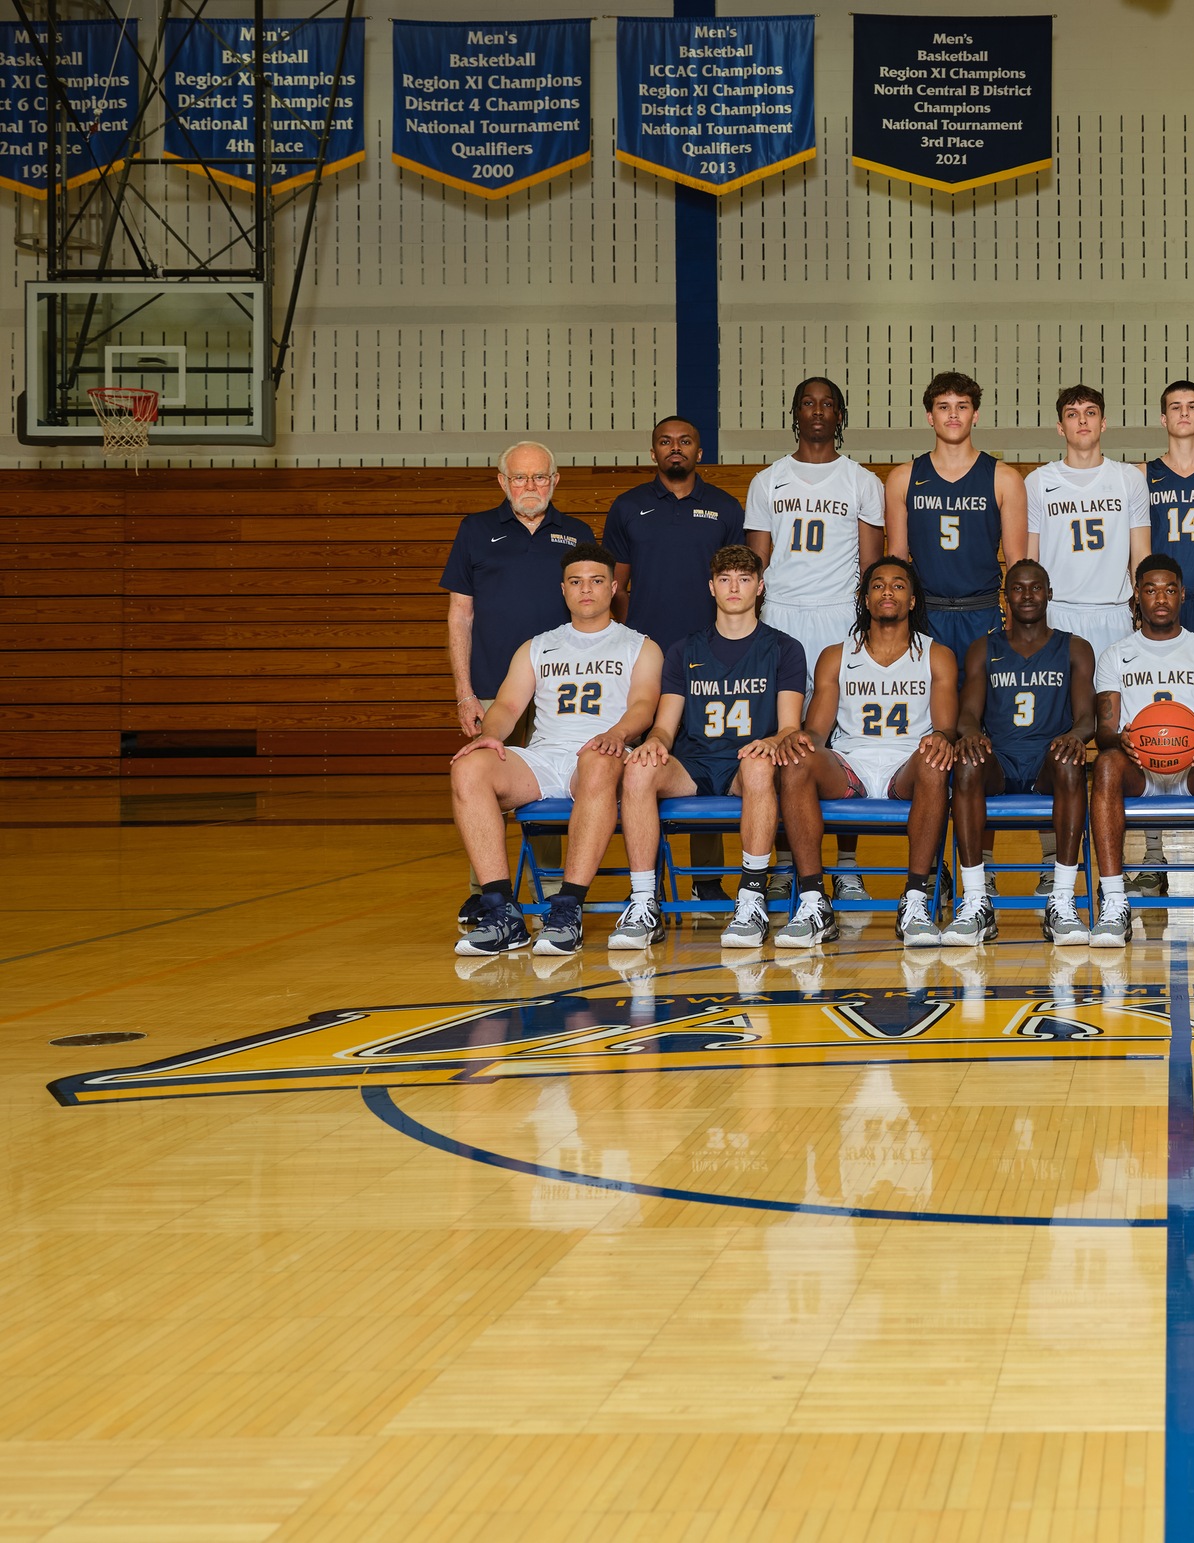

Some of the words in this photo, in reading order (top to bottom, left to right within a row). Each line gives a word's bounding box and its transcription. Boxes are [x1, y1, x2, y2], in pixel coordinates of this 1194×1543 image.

[467, 31, 517, 45] Men's
[694, 26, 737, 38] Men's
[933, 34, 973, 44] Men's
[679, 45, 753, 58] Basketball
[918, 51, 988, 62] Basketball
[449, 52, 536, 68] Basketball
[649, 64, 697, 77] ICCAC
[701, 64, 783, 78] Champions
[880, 67, 927, 81] Region
[930, 68, 946, 78] XI
[950, 68, 1026, 81] Champions
[175, 72, 232, 88] Region
[403, 75, 459, 89] Region
[465, 75, 483, 88] XI
[488, 74, 582, 90] Champions
[639, 84, 688, 99] Region
[693, 84, 708, 96] XI
[712, 83, 794, 98] Champions
[874, 84, 912, 95] North
[917, 85, 966, 96] Central
[970, 86, 979, 95] B
[983, 86, 1032, 96] District
[177, 95, 236, 109] District
[242, 95, 253, 108] 5
[405, 96, 463, 111] District
[469, 97, 480, 110] 4
[486, 96, 580, 112] Champions
[914, 102, 991, 116] Champions
[641, 103, 693, 116] District
[697, 104, 706, 115] 8
[710, 103, 791, 117] Champions
[179, 117, 248, 131] National
[406, 119, 475, 134] National
[481, 119, 580, 133] Tournament
[642, 123, 701, 135] National
[706, 122, 792, 134] Tournament
[882, 119, 937, 130] National
[941, 120, 1023, 130] Tournament
[226, 139, 254, 153] 4th
[451, 142, 533, 157] Qualifiers
[682, 142, 751, 156] Qualifiers
[921, 137, 943, 148] 3rd
[947, 137, 984, 148] Place
[936, 154, 967, 165] 2021
[472, 164, 514, 178] 2000
[700, 162, 736, 174] 2013
[914, 495, 942, 511] IOWA
[946, 496, 987, 511] LAKES
[1150, 490, 1177, 506] IOWA
[773, 499, 801, 515] IOWA
[806, 499, 849, 517] LAKES
[1047, 501, 1077, 517] IOWA
[1081, 498, 1122, 514] LAKES
[790, 518, 825, 553] 10
[939, 515, 960, 551] 5
[1070, 517, 1105, 553] 15
[540, 661, 570, 679] IOWA
[575, 660, 624, 676] LAKES
[690, 680, 720, 696] IOWA
[724, 677, 768, 694] LAKES
[990, 672, 1018, 688] IOWA
[1022, 671, 1063, 686] LAKES
[1123, 672, 1153, 688] IOWA
[845, 681, 875, 697] IOWA
[881, 680, 926, 696] LAKES
[557, 681, 601, 716] 22
[1013, 691, 1036, 727] 3
[704, 699, 752, 738] 34
[862, 702, 909, 736] 24
[1140, 735, 1189, 747] SPALDING
